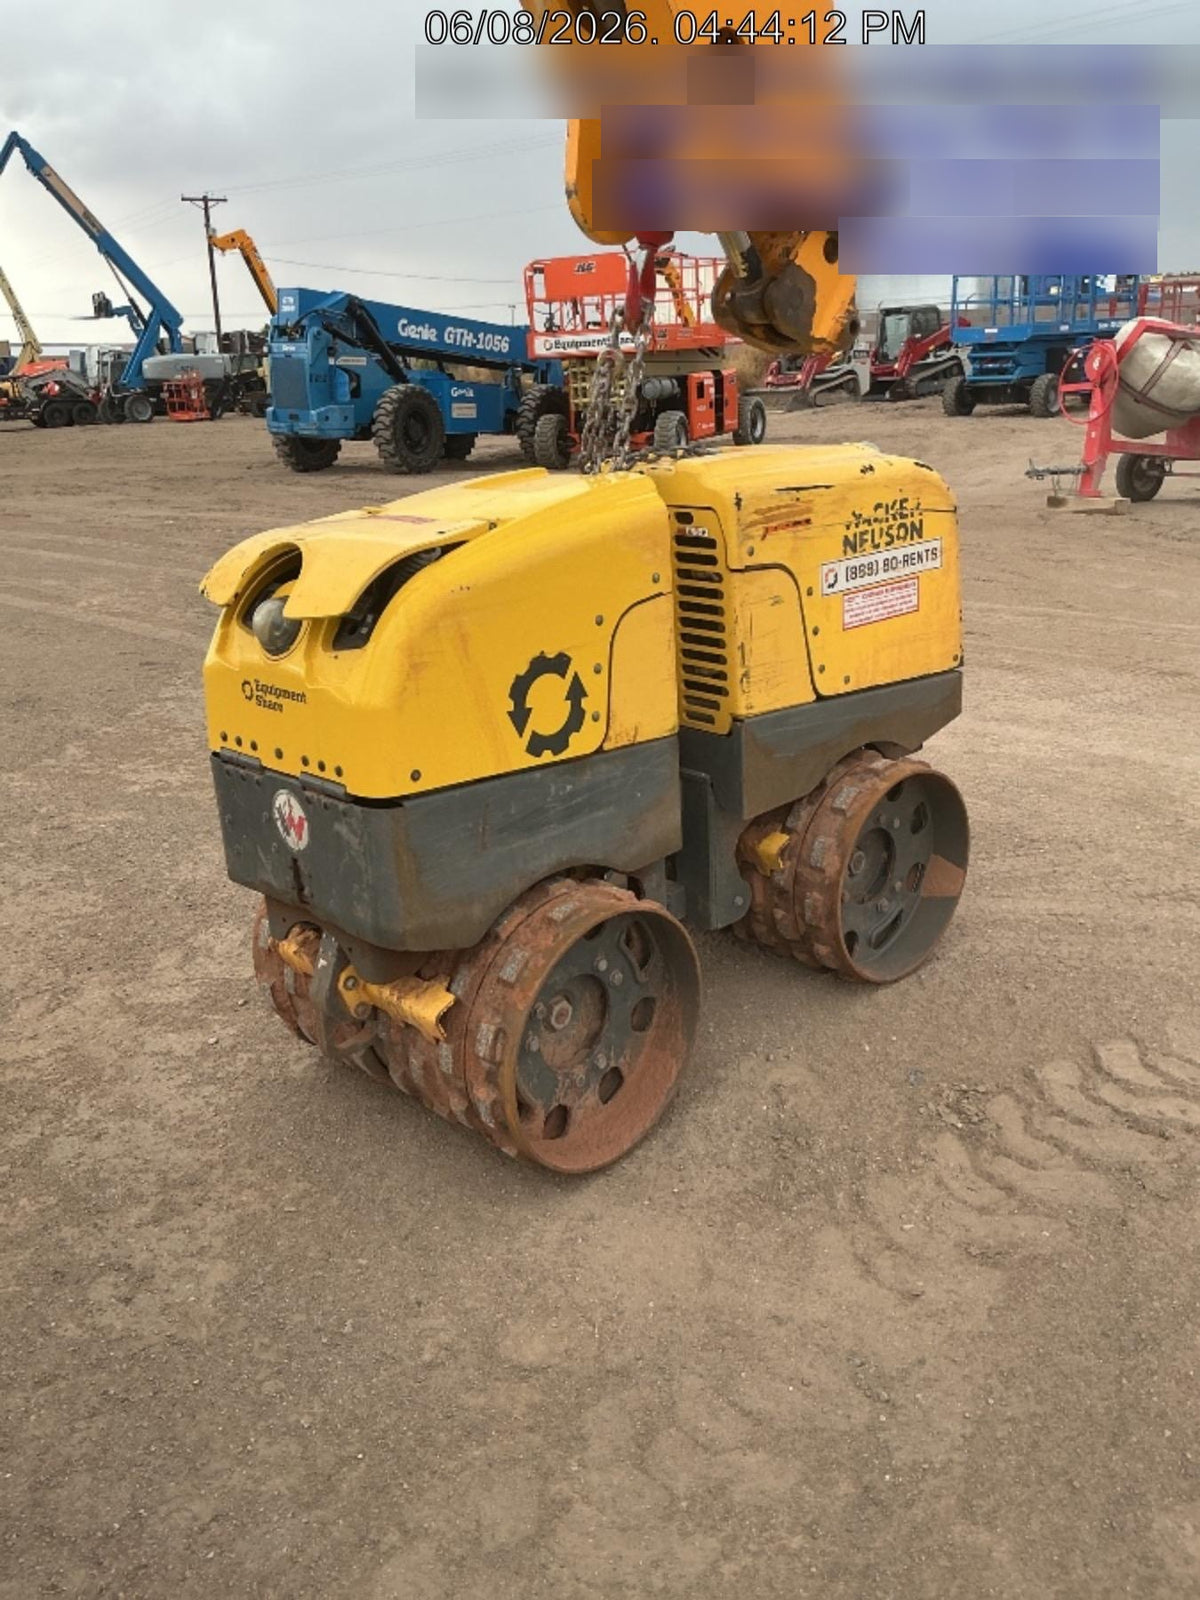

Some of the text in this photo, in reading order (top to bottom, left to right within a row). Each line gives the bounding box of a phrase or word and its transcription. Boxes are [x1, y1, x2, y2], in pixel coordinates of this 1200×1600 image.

[398, 318, 510, 353] Genie GTH-1056
[254, 678, 307, 704] Equipment
